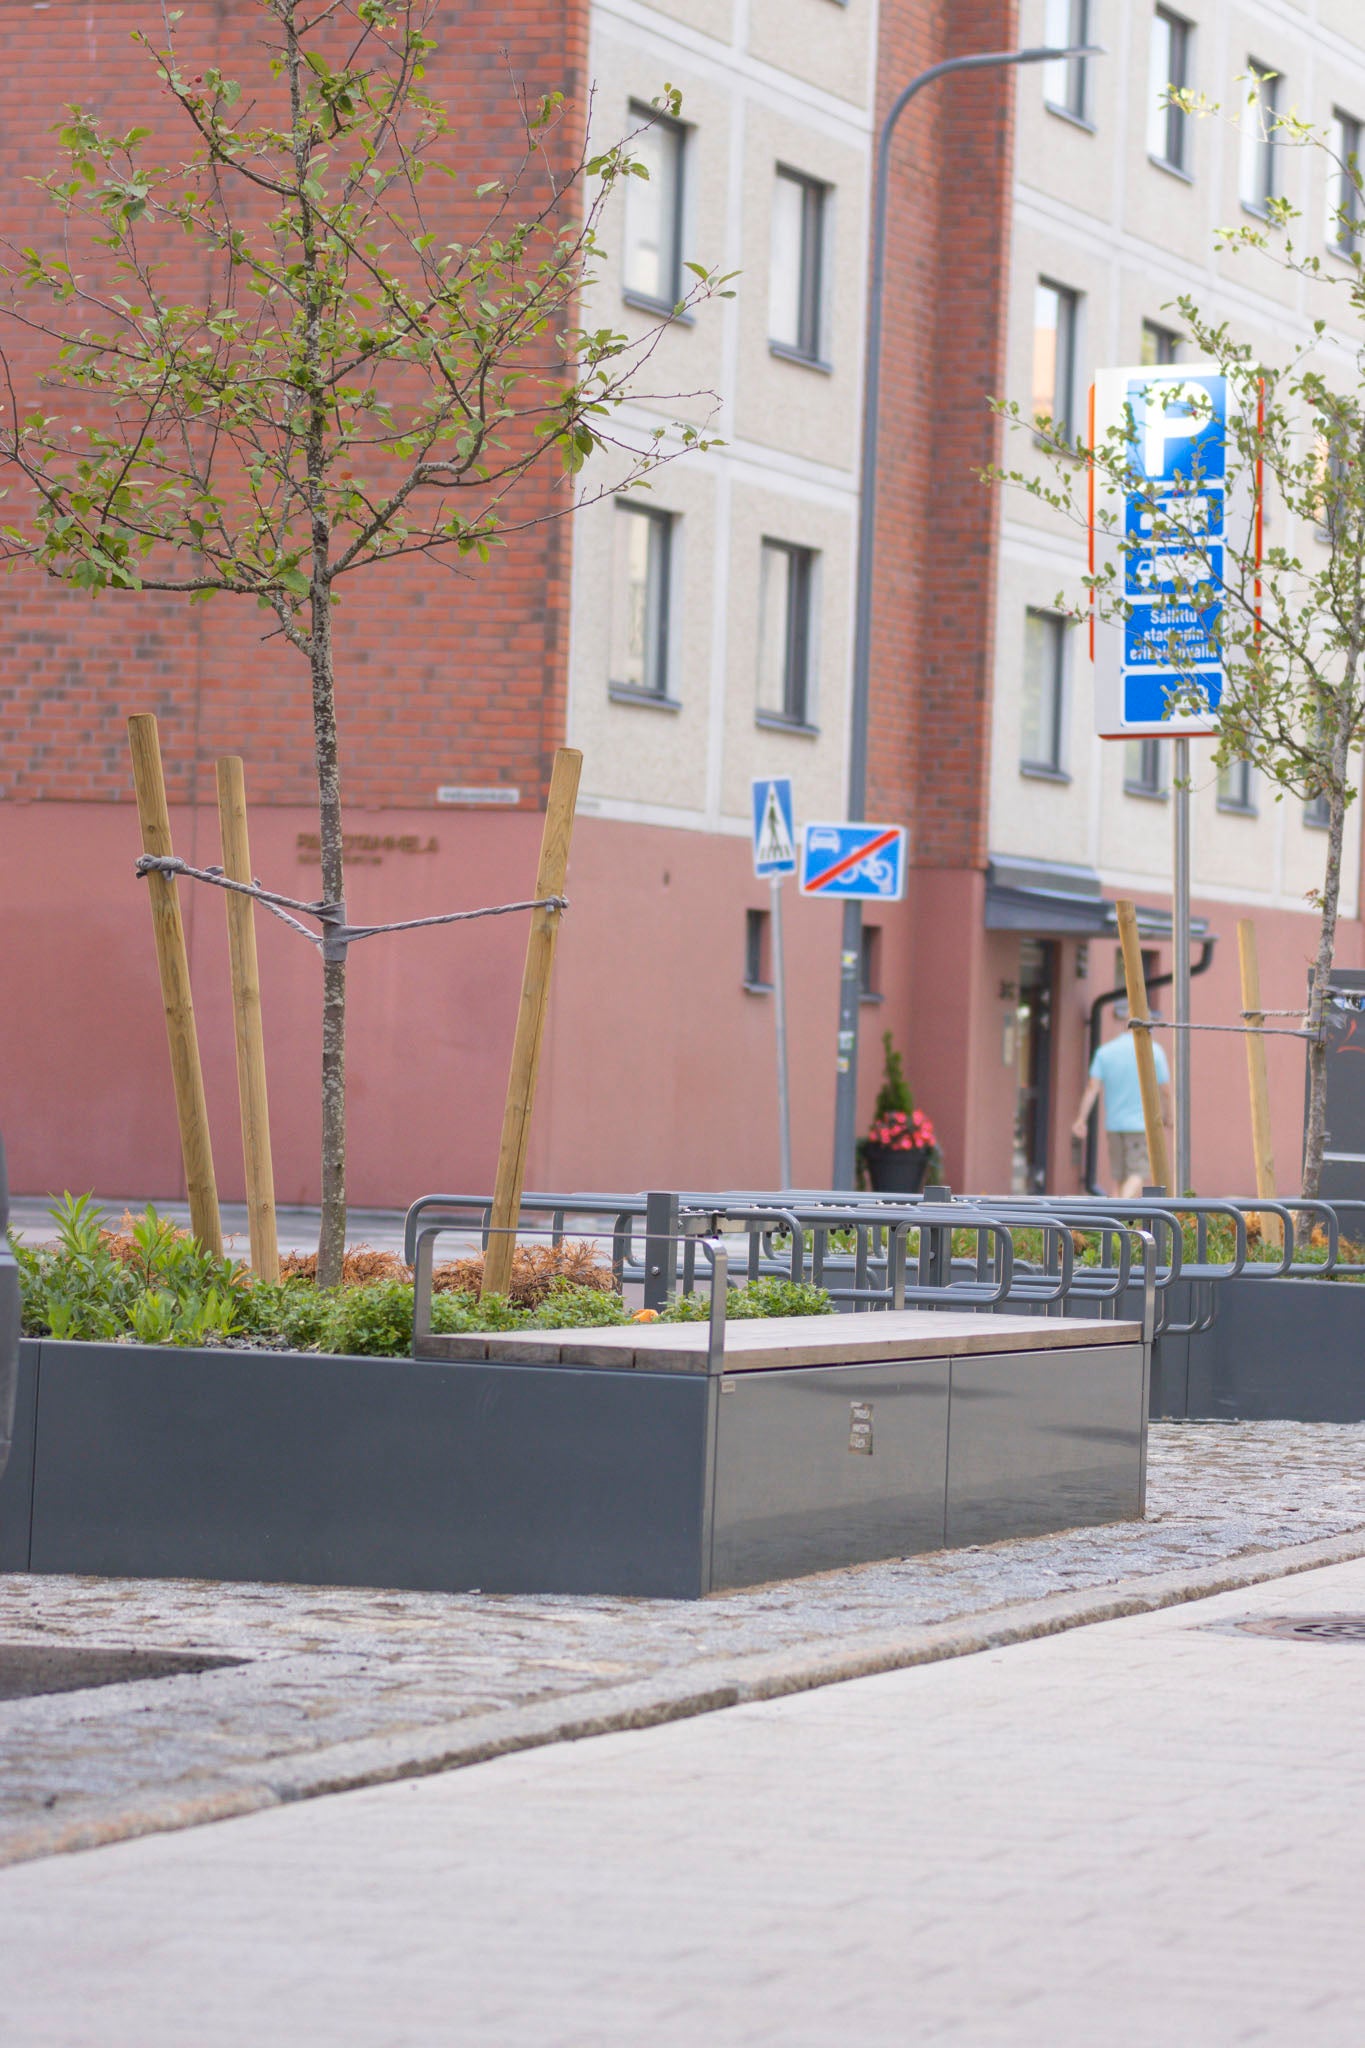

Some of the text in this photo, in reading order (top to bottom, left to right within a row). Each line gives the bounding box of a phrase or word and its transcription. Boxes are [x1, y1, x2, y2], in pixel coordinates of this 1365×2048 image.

[1145, 381, 1213, 477] P
[1150, 609, 1198, 625] Sallittu
[1143, 626, 1204, 642] stadnin
